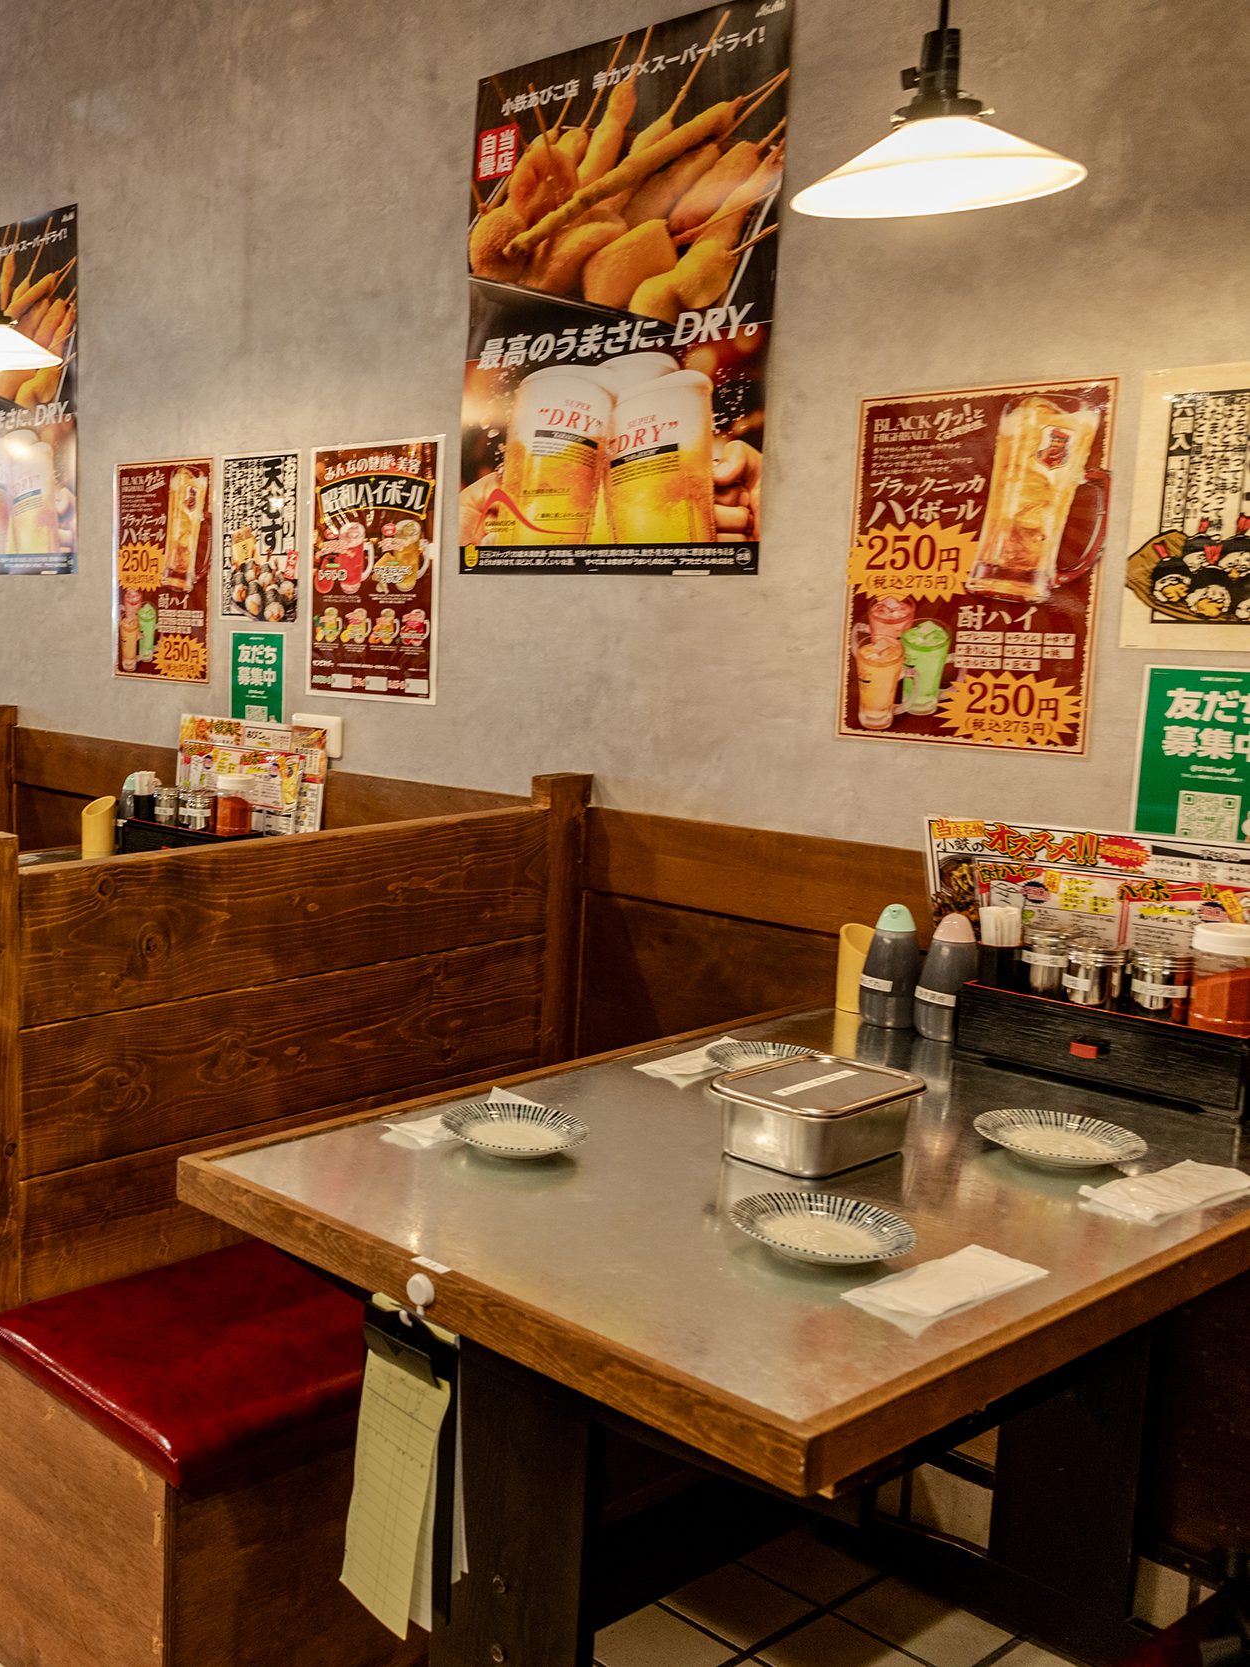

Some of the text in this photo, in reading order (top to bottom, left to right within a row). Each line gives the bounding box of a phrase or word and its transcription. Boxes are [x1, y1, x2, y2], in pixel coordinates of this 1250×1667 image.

[500, 79, 580, 117] 小鉄あびこ店
[497, 128, 516, 173] 当店
[874, 414, 932, 432] BLACK
[873, 430, 931, 443] HIGHBALL
[320, 480, 426, 514] 昭和ハイボール
[870, 474, 986, 497] ブラックニッカ
[865, 498, 983, 528] ハイボール
[121, 528, 167, 545] ハイボール
[122, 549, 159, 574] 250円
[867, 534, 960, 572] 250円
[158, 593, 189, 609] 酎ハイ
[957, 604, 1038, 631] 酎ハイ
[164, 640, 200, 664] 250円
[238, 644, 277, 665] 友だち
[237, 666, 277, 687] 募集中
[966, 682, 1059, 721] 250円
[1164, 687, 1250, 724] 友だ
